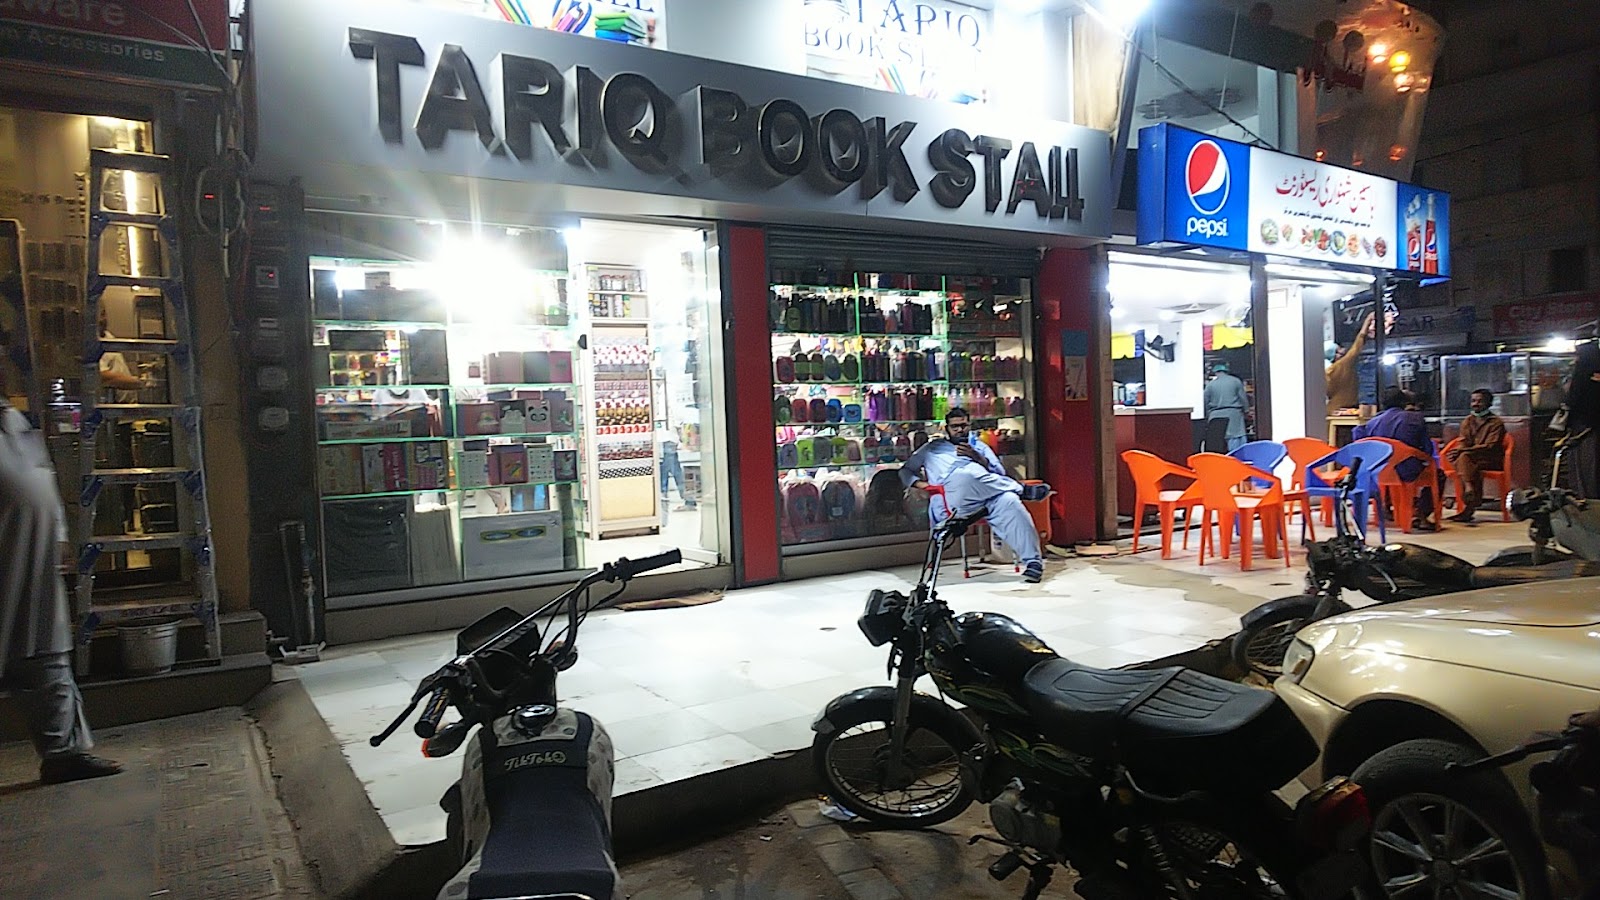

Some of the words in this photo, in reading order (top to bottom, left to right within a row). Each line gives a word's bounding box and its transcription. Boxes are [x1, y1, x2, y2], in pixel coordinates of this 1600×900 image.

[29, 28, 165, 63] Accessories
[804, 24, 885, 60] BOOK
[348, 26, 682, 182] TARIQ
[694, 85, 920, 204] BOOK
[927, 128, 1086, 222] STALL
[1186, 216, 1229, 239] pepsi
